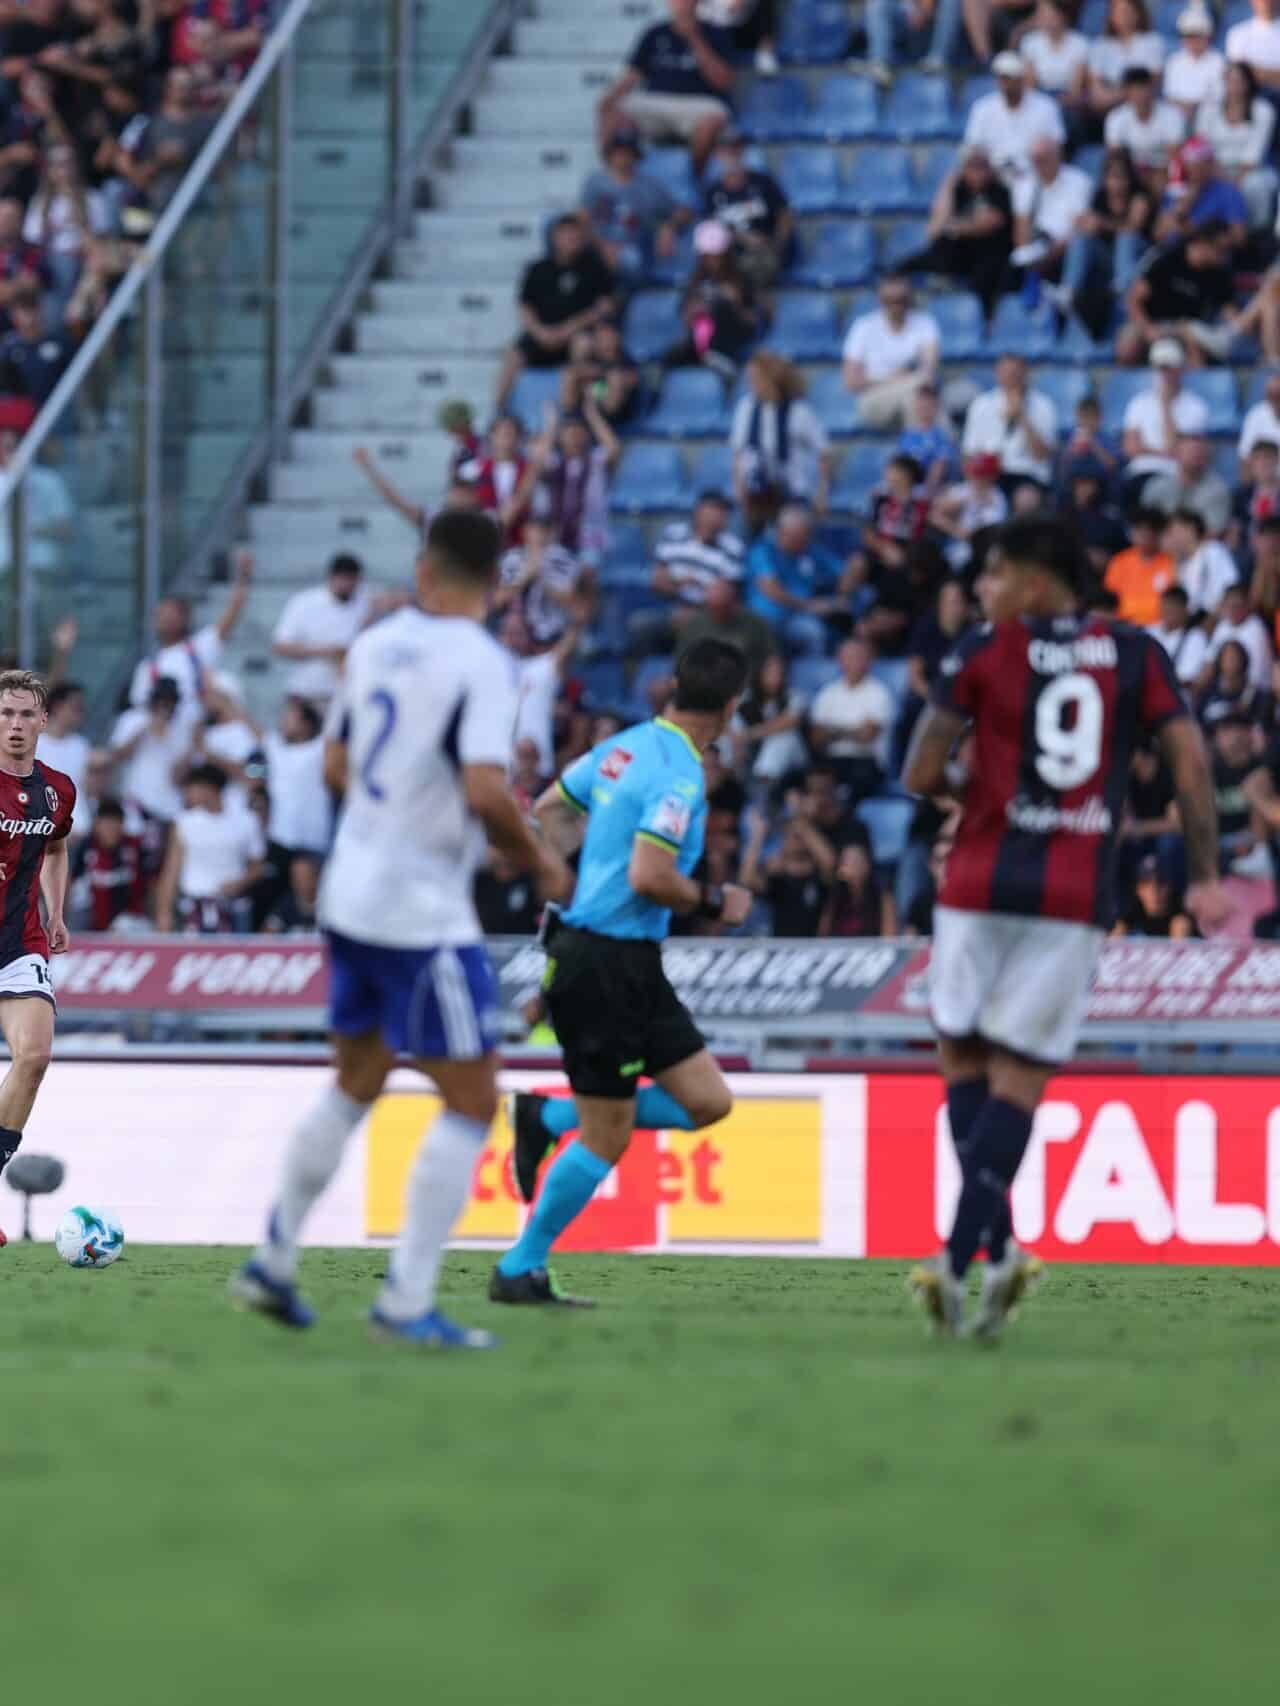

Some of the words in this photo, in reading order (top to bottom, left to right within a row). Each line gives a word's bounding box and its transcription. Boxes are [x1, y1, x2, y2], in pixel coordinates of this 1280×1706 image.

[362, 686, 397, 801] 2
[1035, 673, 1103, 790] 9
[169, 951, 322, 994] YORK
